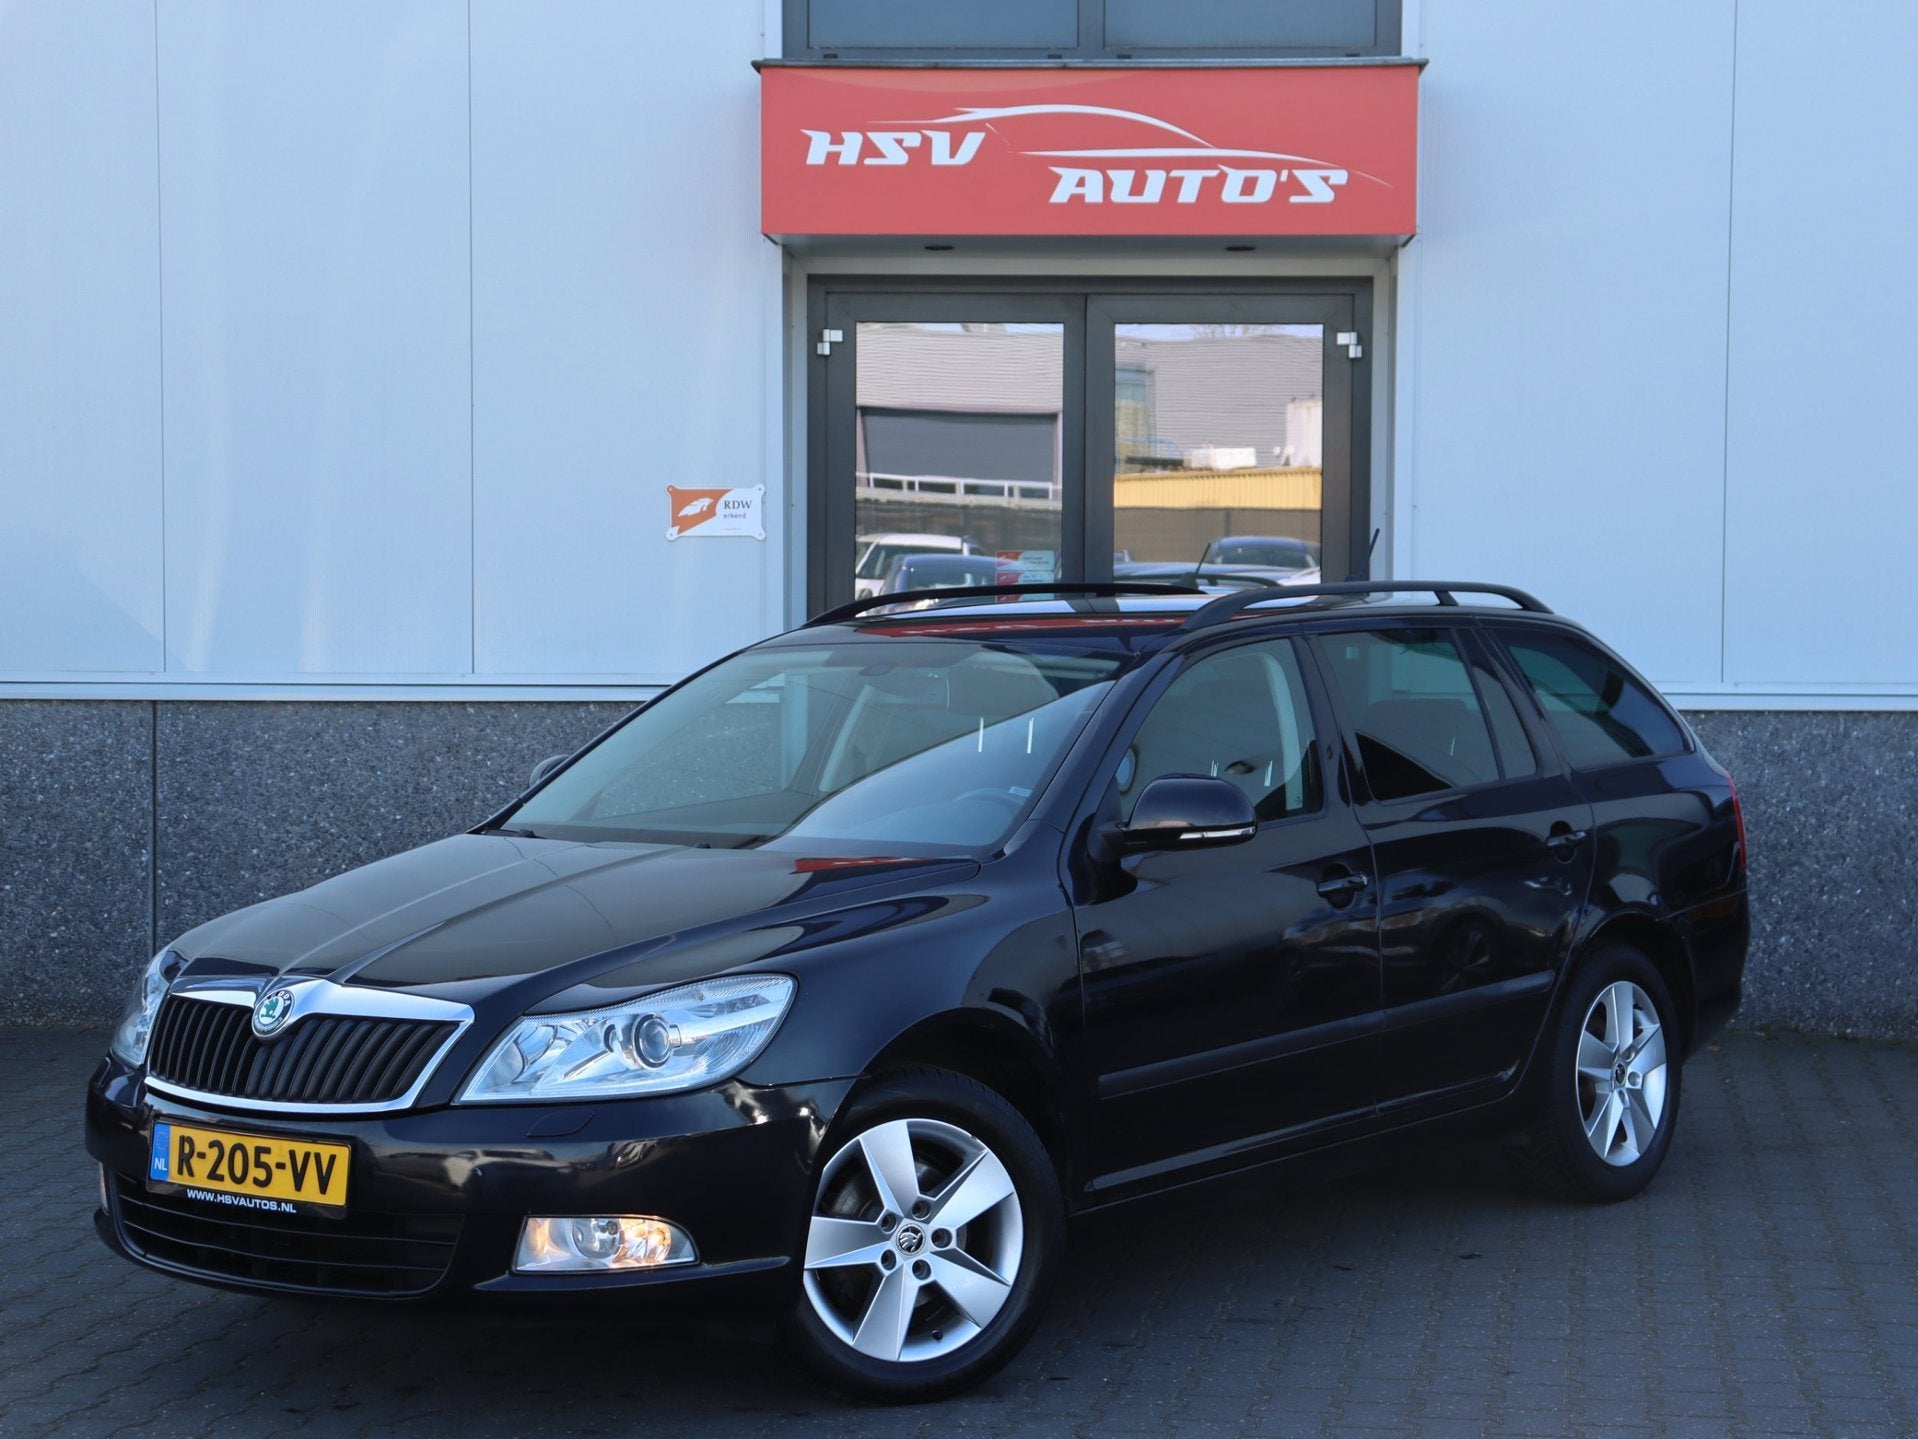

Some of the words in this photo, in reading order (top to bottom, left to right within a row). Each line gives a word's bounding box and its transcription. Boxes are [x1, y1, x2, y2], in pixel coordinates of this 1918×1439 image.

[801, 130, 986, 166] HSV
[1049, 164, 1349, 204] AUTO'S
[724, 500, 752, 510] RDW
[154, 1157, 168, 1171] NL
[176, 1134, 337, 1195] R-205-VV
[186, 1188, 297, 1213] WWW.HSVAUTOS.NL
